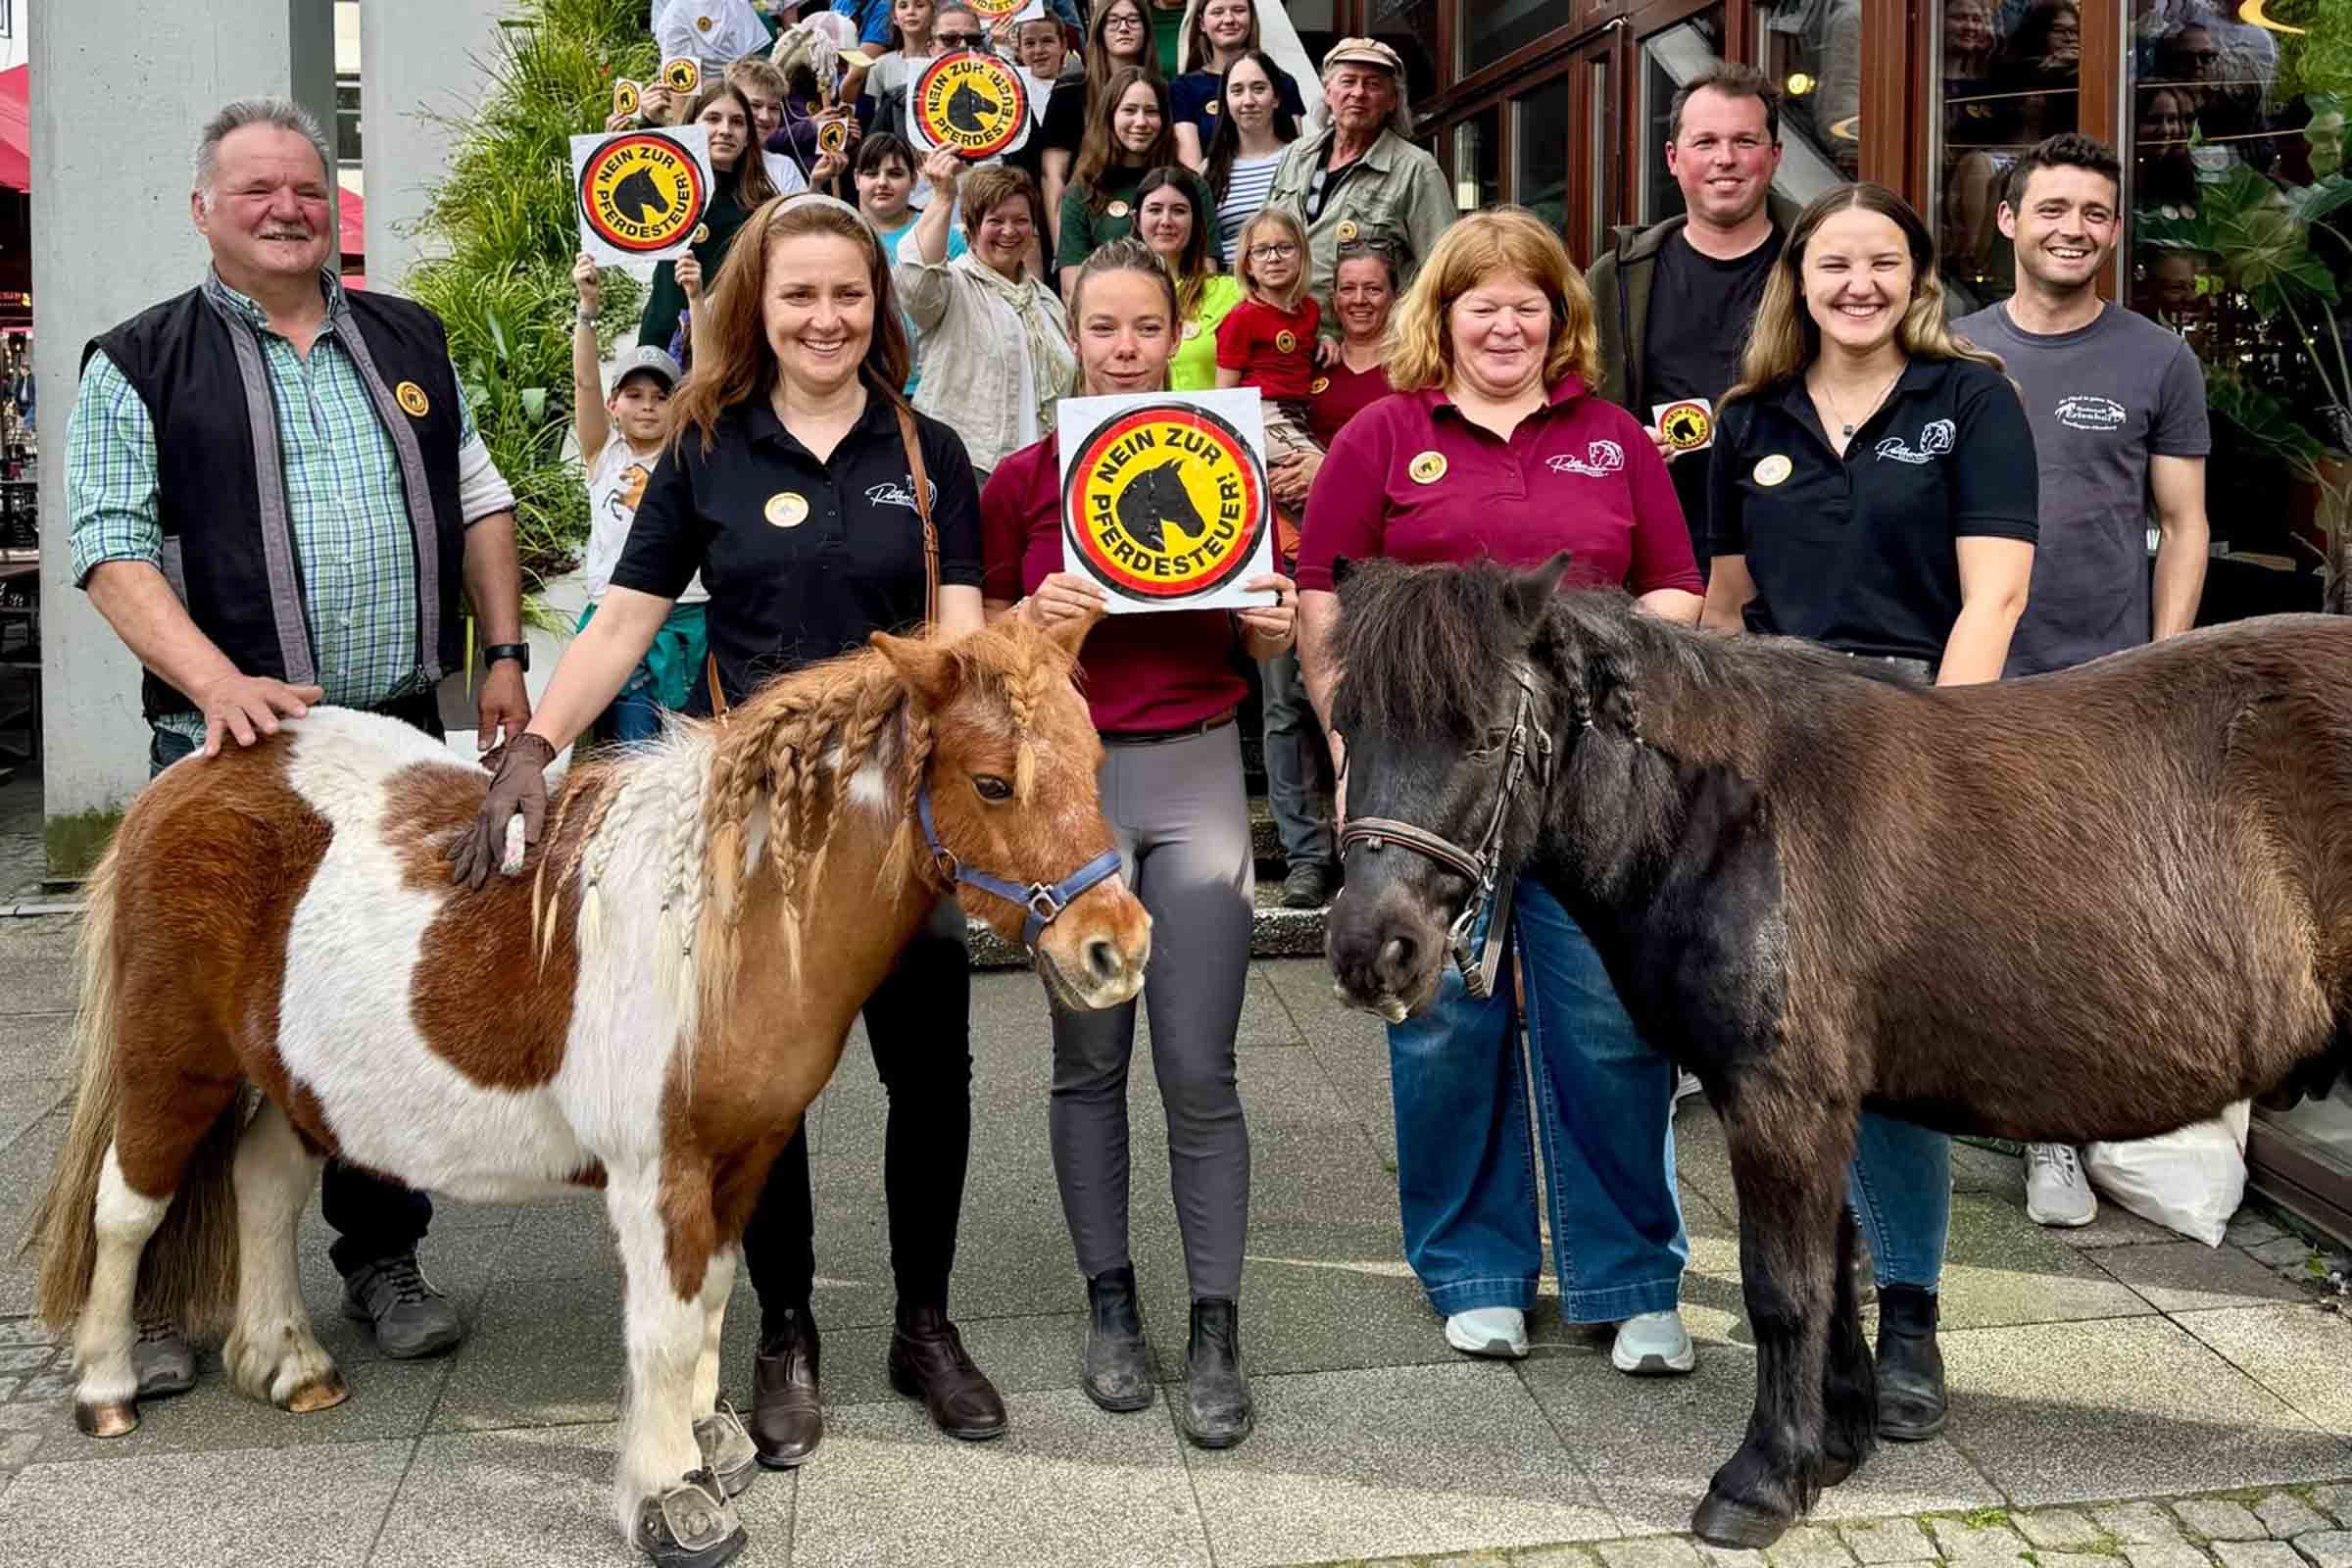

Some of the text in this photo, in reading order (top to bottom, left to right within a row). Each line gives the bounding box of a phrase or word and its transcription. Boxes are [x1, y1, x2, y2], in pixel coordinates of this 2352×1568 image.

[928, 62, 985, 113] NEIN ZUR
[598, 146, 676, 183] NEIN ZUR
[596, 172, 691, 238] PFERDESTEUER!
[1096, 427, 1223, 484] NEIN ZUR
[1092, 471, 1241, 577] PFERDESTEUER!
